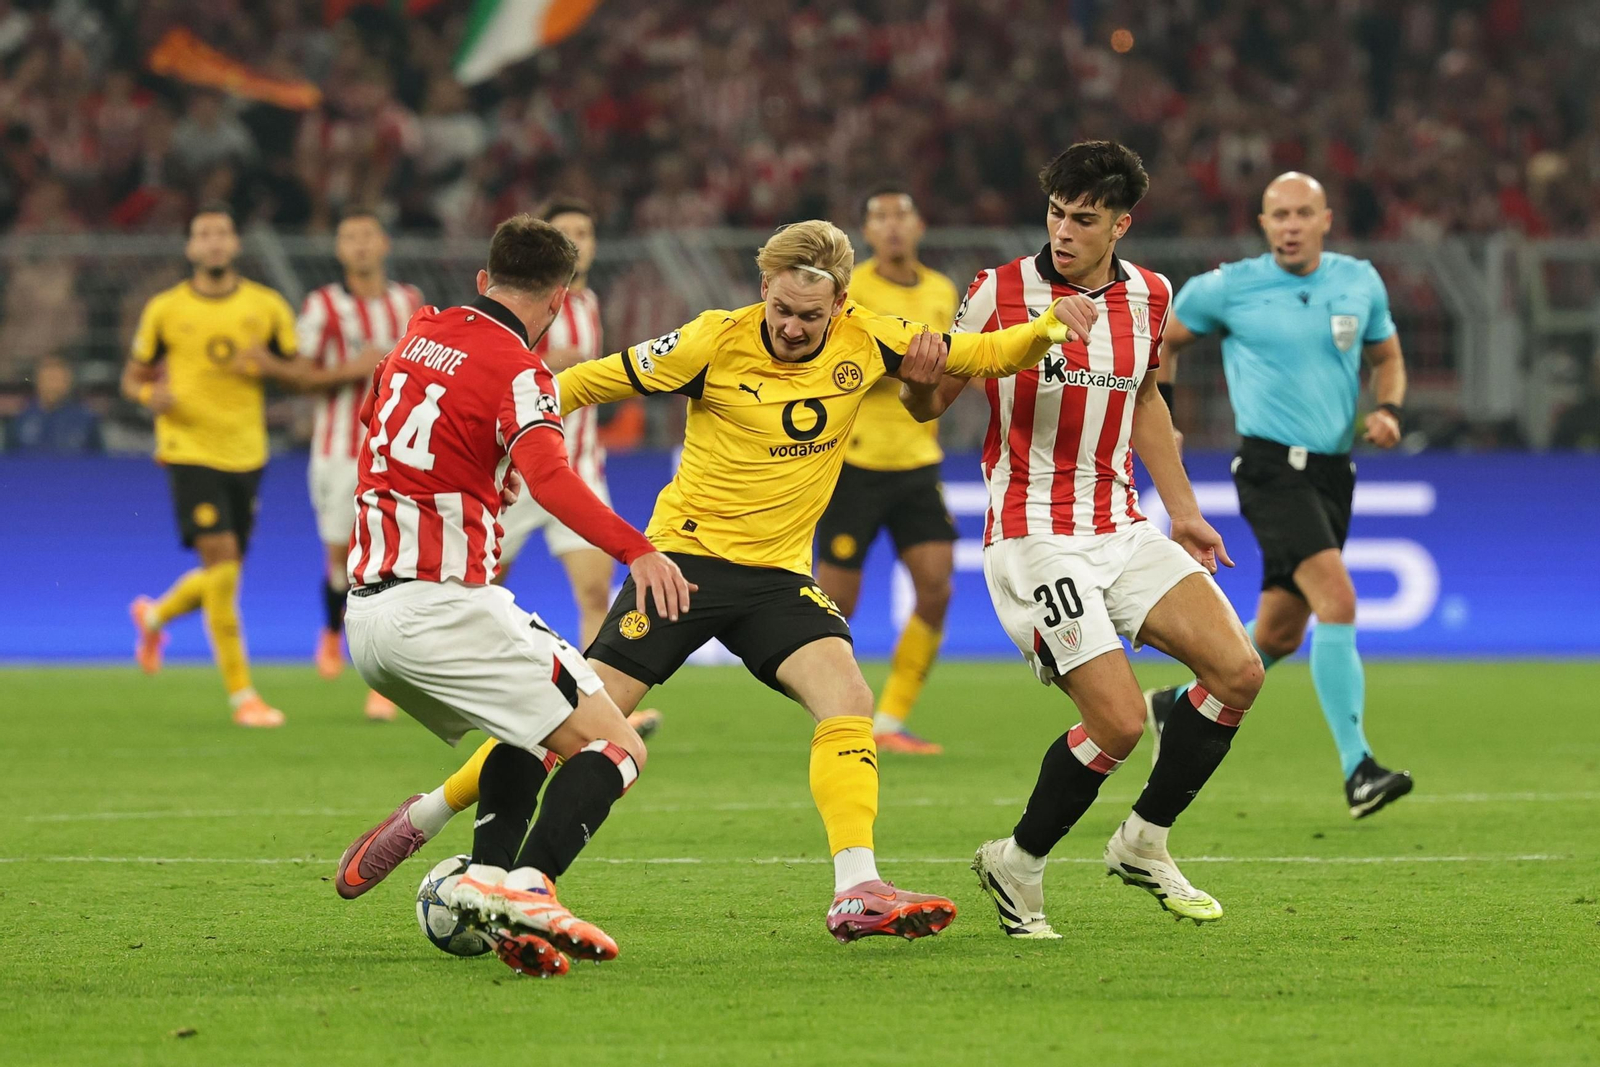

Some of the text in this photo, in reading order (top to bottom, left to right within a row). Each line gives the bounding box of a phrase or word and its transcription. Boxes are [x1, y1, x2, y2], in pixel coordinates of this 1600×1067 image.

[400, 335, 468, 376] LAPORTE
[837, 365, 859, 384] BVB
[1043, 352, 1139, 391] Kutxabank
[369, 372, 447, 473] 14
[769, 438, 838, 457] vodafone
[1033, 576, 1084, 628] 30
[623, 614, 646, 633] BVB
